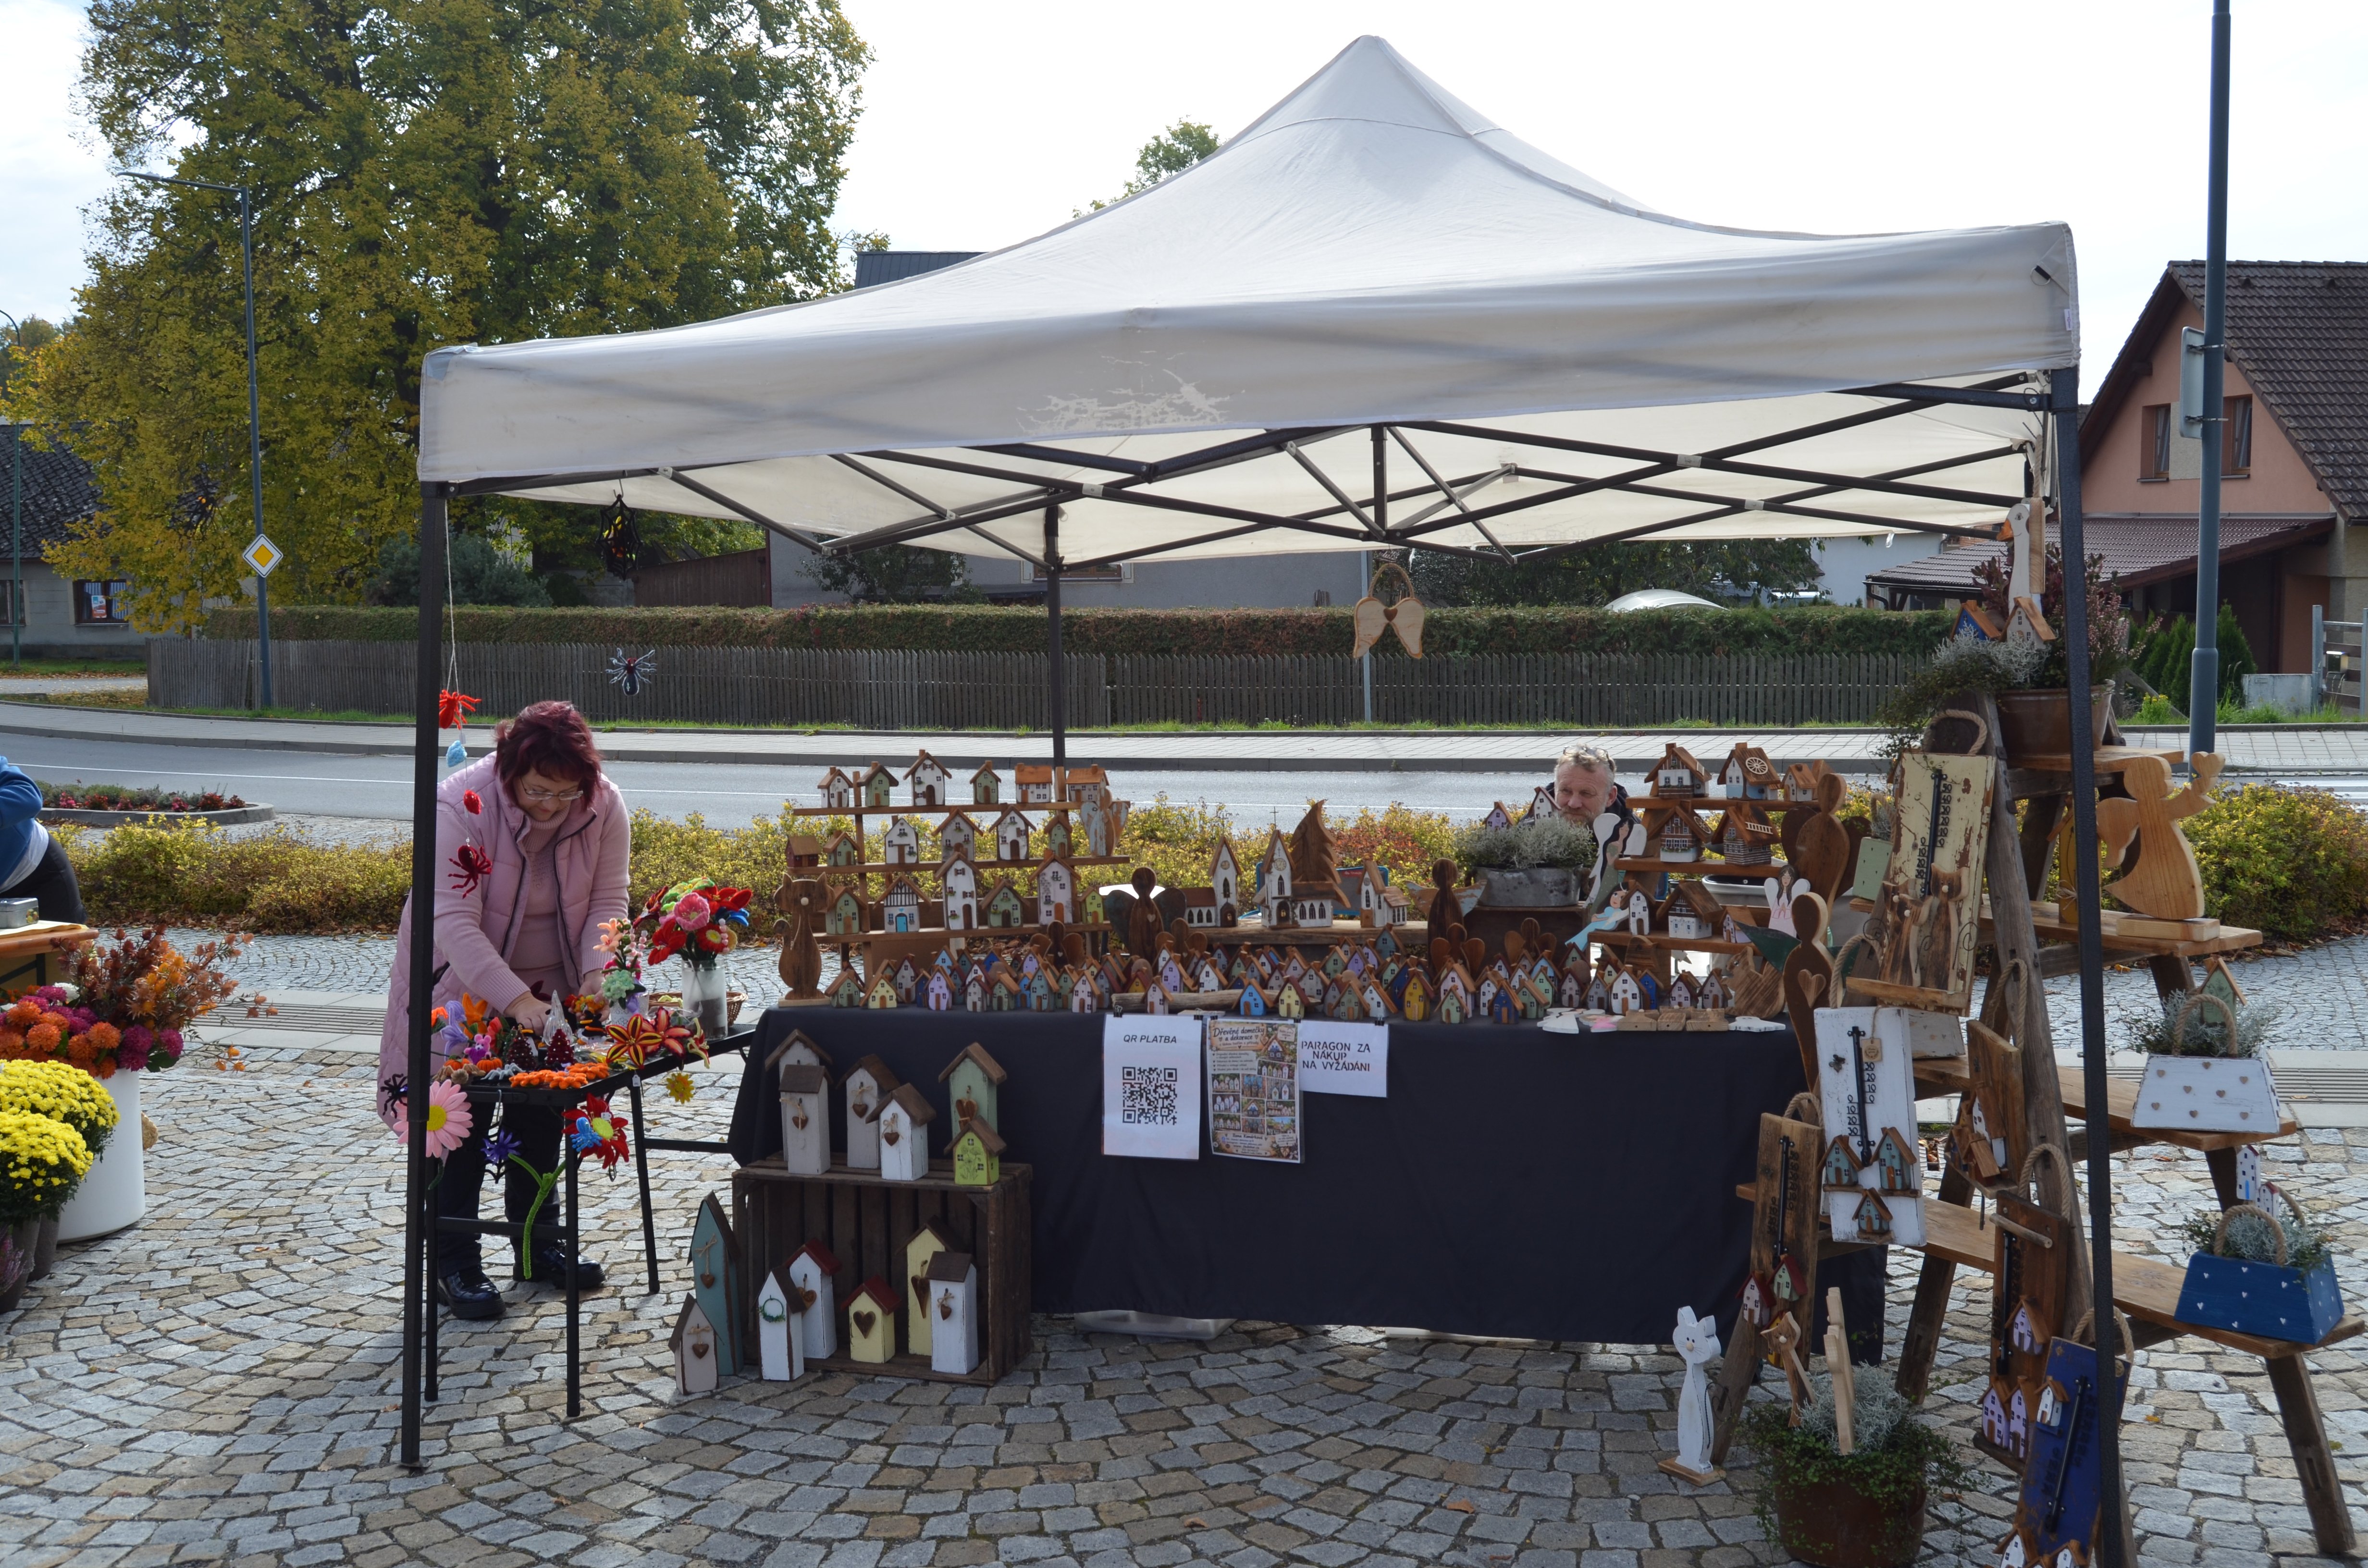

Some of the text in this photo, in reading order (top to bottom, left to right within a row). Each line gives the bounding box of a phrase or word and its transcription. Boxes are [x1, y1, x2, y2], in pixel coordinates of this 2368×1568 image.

[1942, 784, 1952, 792] 50
[1942, 795, 1951, 803] 40
[1941, 806, 1951, 814] 30
[1941, 817, 1949, 825] 20
[1940, 827, 1949, 836] 10
[1920, 837, 1926, 845] 0
[1939, 838, 1945, 846] 0
[1918, 848, 1926, 856] 10
[1917, 858, 1925, 867] 20
[1915, 870, 1924, 878] 30
[1213, 1027, 1265, 1037] Dřevěné domečky
[1123, 1034, 1177, 1043] QR PLATBA
[1302, 1041, 1370, 1053] PARAGON ZA
[1313, 1050, 1347, 1061] NÁKUP
[1303, 1060, 1317, 1069] NA
[1865, 1062, 1875, 1070] 30
[1866, 1073, 1875, 1081] 20
[1868, 1084, 1876, 1092] 10
[1847, 1094, 1853, 1102] 0
[1869, 1095, 1875, 1103] 0
[1847, 1105, 1856, 1114] 10
[1847, 1116, 1857, 1125] 20
[1848, 1127, 1858, 1136] 30
